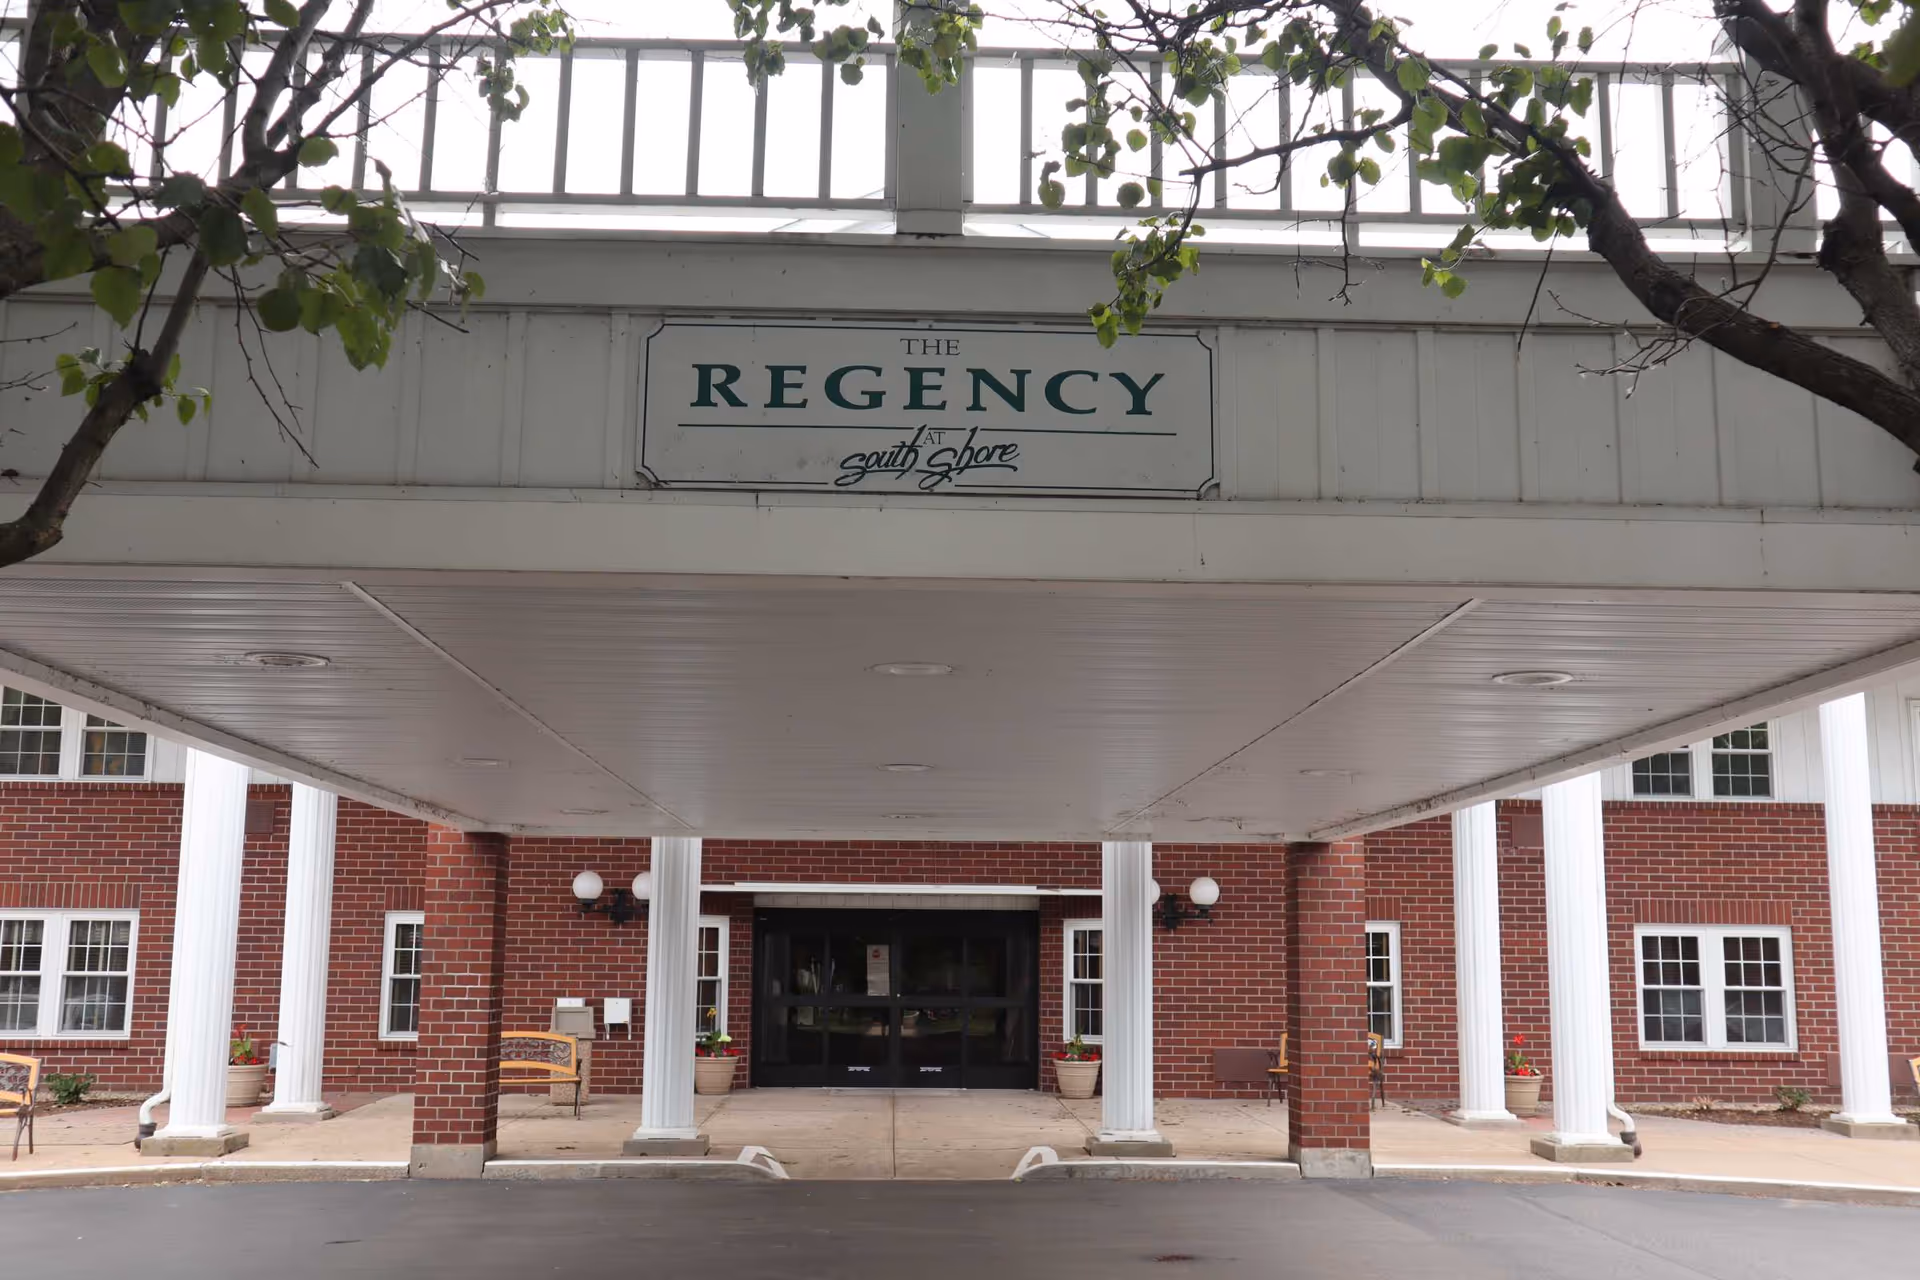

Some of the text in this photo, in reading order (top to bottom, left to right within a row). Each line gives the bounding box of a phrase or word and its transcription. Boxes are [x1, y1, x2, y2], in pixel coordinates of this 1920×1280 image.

[901, 337, 961, 357] THE
[689, 363, 1166, 417] REGENCY
[923, 431, 946, 446] AT
